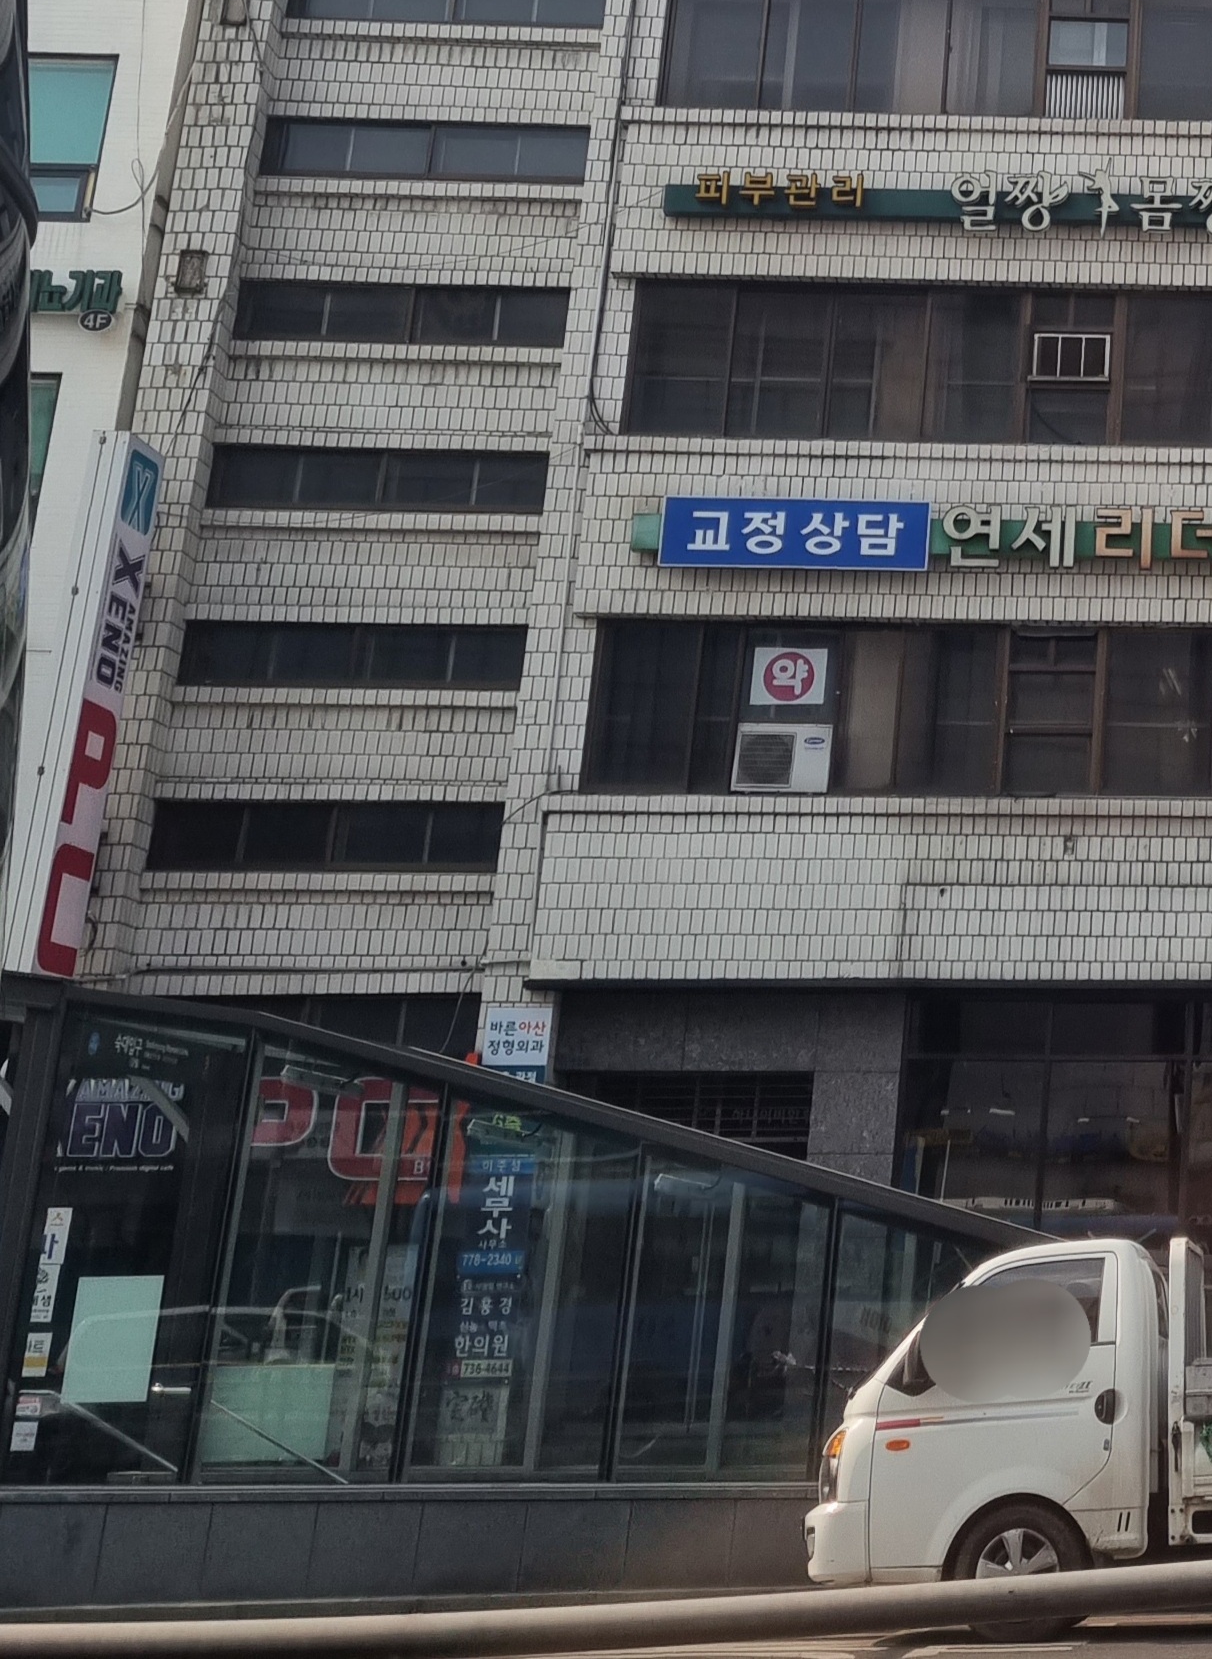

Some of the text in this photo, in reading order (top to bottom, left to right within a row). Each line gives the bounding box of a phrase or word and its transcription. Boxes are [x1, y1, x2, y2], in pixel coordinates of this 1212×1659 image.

[694, 170, 866, 210] 피부관리
[950, 169, 1070, 232] 얼짱
[84, 314, 109, 329] 4F
[686, 510, 905, 557] 교정상담
[96, 538, 146, 690] XENO
[113, 601, 137, 694] AMAZING
[487, 1039, 544, 1056] 정형외과
[490, 1020, 546, 1037] 바른아산
[477, 1175, 515, 1239] 세무사
[454, 1334, 509, 1357] 한의원
